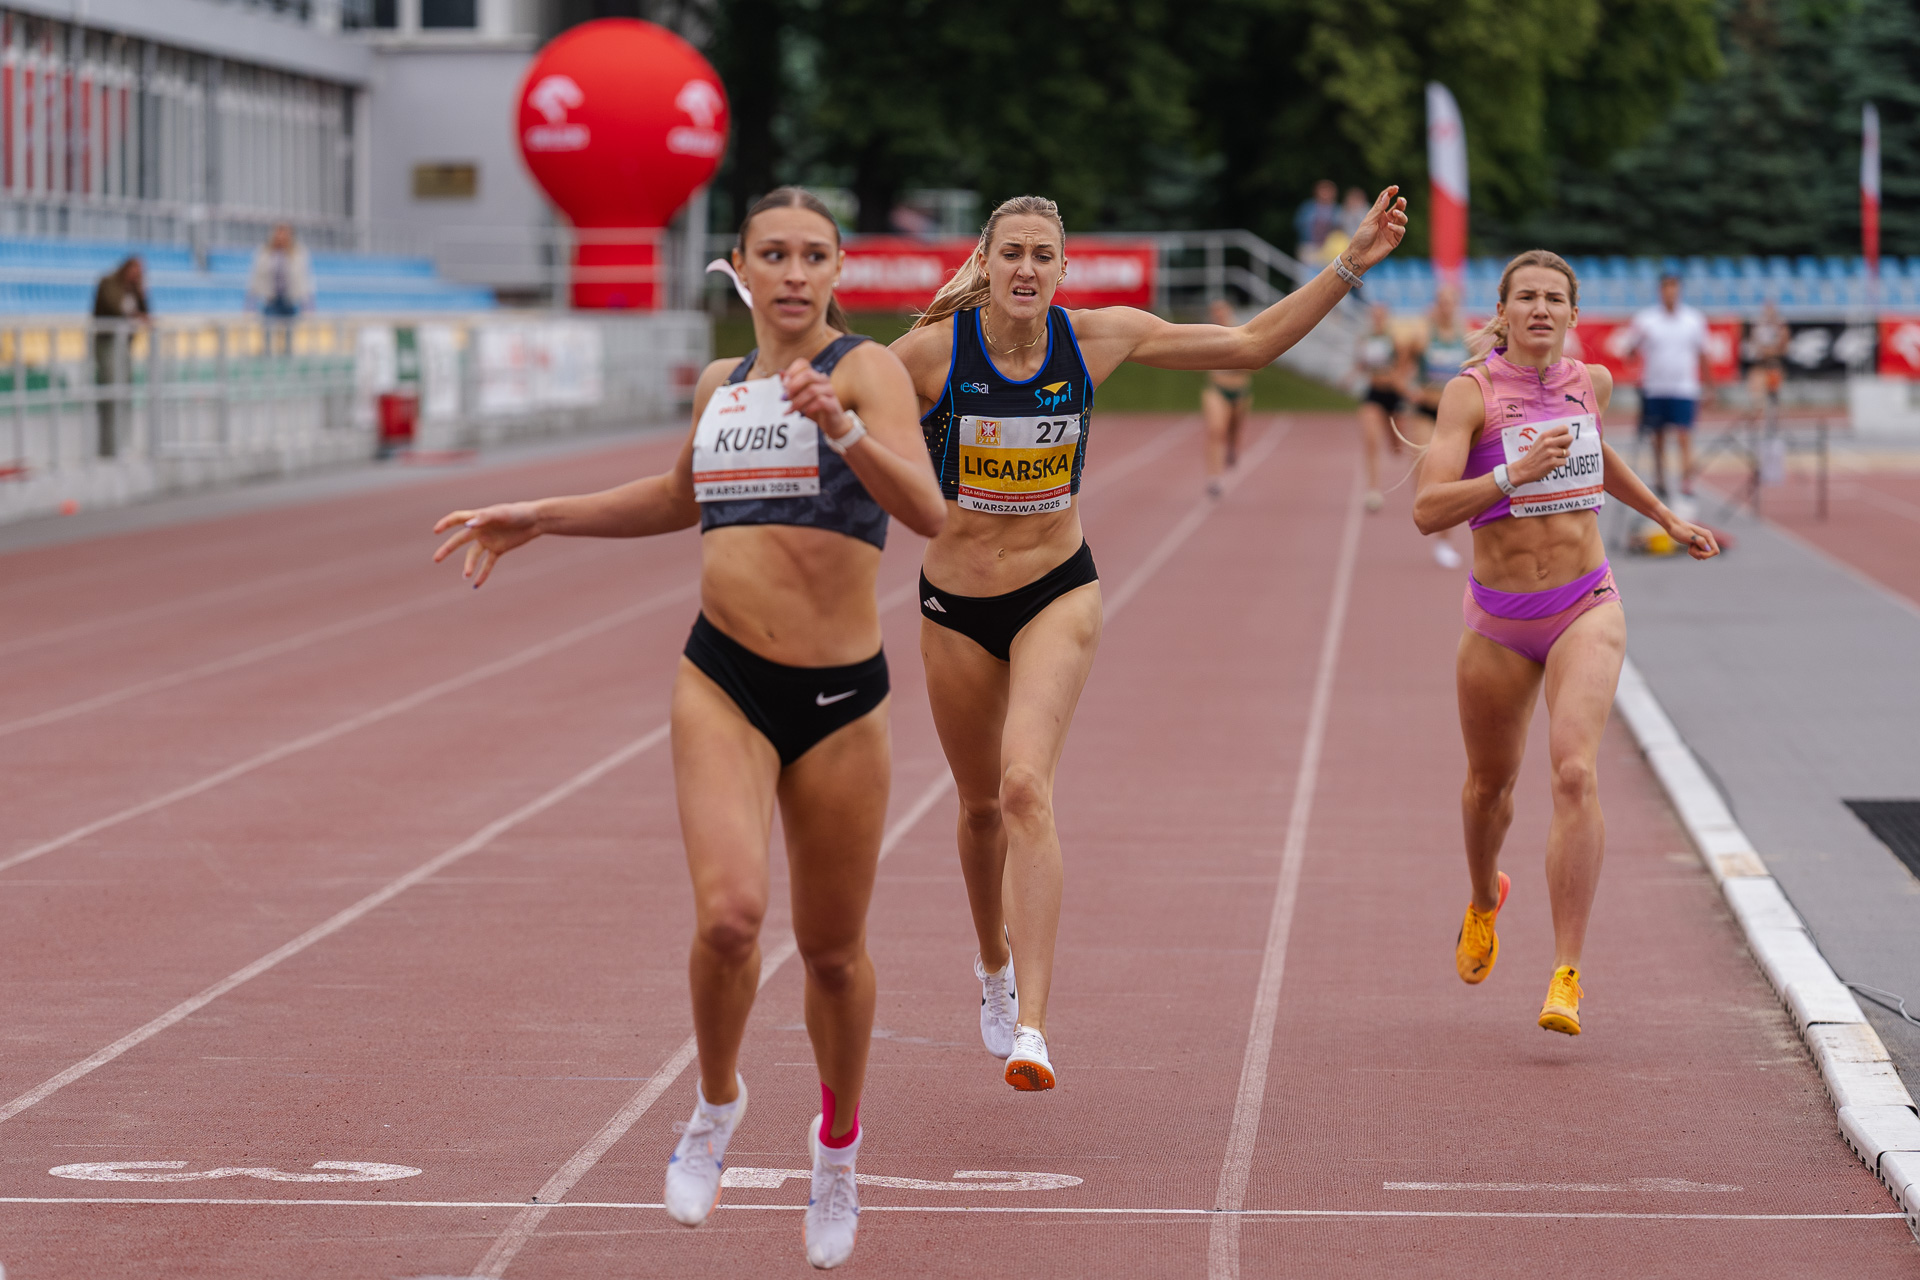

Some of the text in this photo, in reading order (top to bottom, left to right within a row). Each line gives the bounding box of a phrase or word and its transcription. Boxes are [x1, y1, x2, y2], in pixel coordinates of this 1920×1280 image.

[1034, 382, 1073, 412] Sopot
[714, 423, 789, 454] KUBIS
[1035, 420, 1068, 444] 27
[964, 453, 1069, 481] LIGARSKA
[972, 499, 1061, 513] WARSZAWA 2025
[1524, 500, 1581, 514] WARSZAWA
